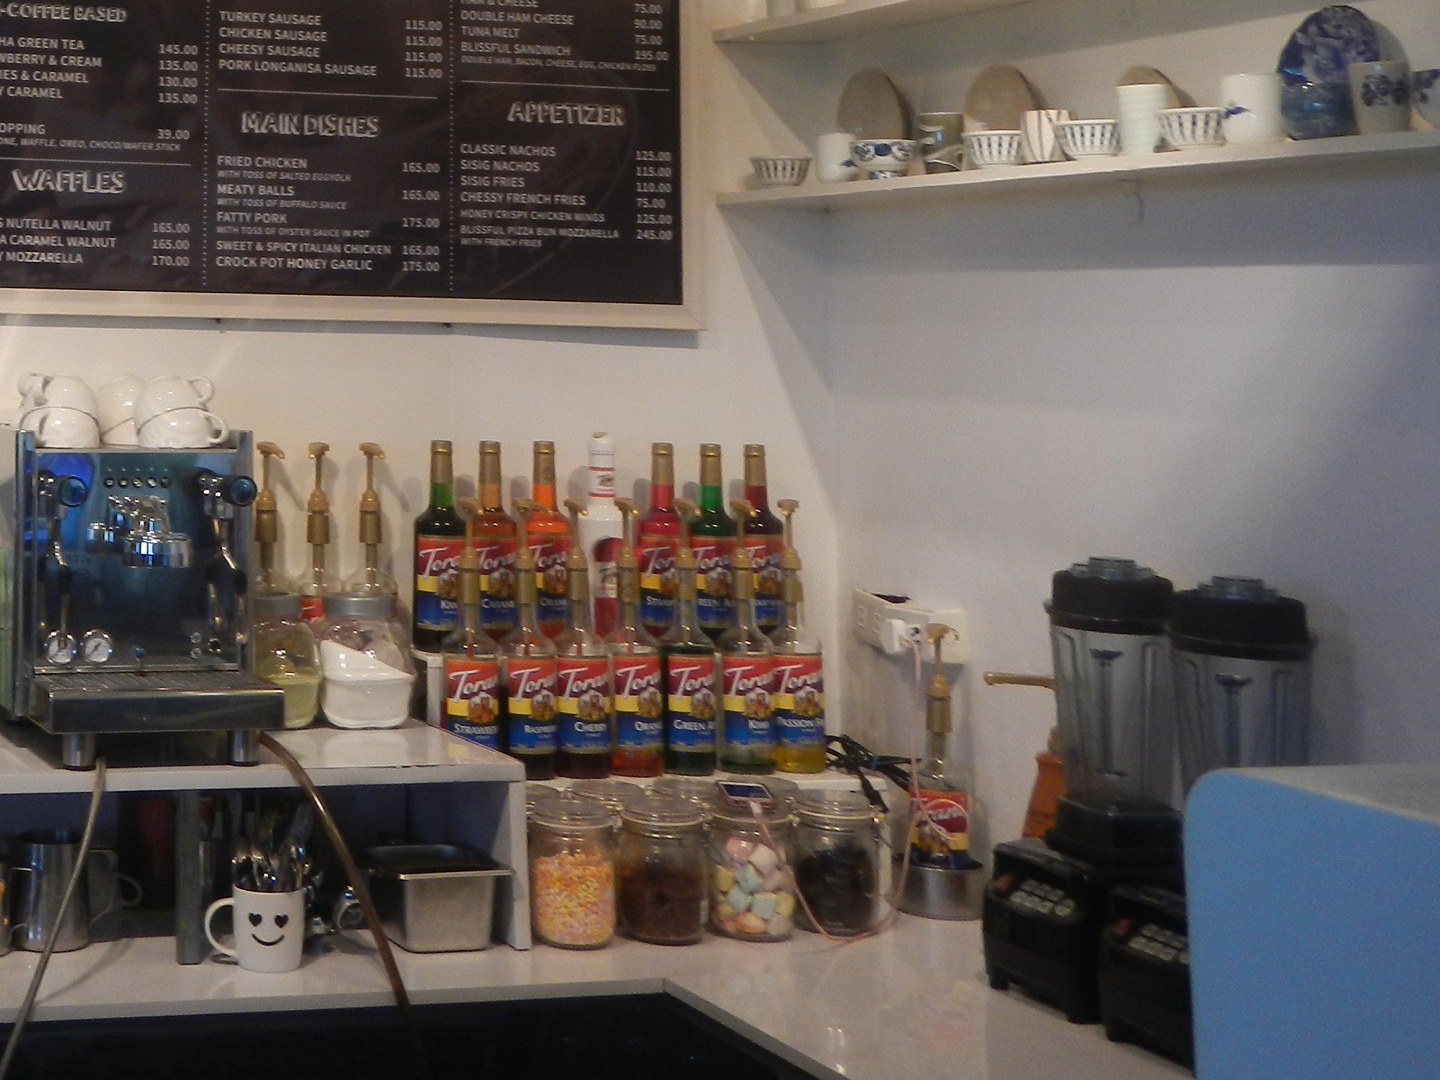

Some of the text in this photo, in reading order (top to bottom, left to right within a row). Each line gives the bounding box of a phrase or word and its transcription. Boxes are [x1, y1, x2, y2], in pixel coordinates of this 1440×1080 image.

[74, 5, 127, 23] BASED
[219, 10, 321, 25] TURKEY SAUSAGE
[219, 27, 327, 42] CHICKEN SAUSAGE
[18, 37, 58, 49] GREEN
[62, 39, 84, 50] TEA
[219, 43, 320, 57] CHEESY SAUSAGE
[60, 56, 102, 68] CREAM
[219, 59, 377, 76] PORK LONGANISA SAUSAGE
[33, 71, 89, 83] CARAMEL
[7, 87, 63, 99] CARAMEL
[507, 101, 626, 126] APPETIZER
[461, 143, 556, 157] CLASSIC NACHOS
[217, 155, 307, 169] FRIED CHICKEN
[12, 169, 126, 194] WAFFLES
[217, 184, 294, 197] MEATY BALLS
[507, 193, 586, 206] FRENCH FRIES
[7, 218, 60, 230] NUTELLA
[62, 220, 112, 231] WALNUT
[10, 235, 64, 246] CARAMEL
[67, 237, 116, 248] WALNUT
[6, 252, 83, 264] MOZZARELLA
[216, 256, 373, 270] CROCK POT HONEY GARLIC
